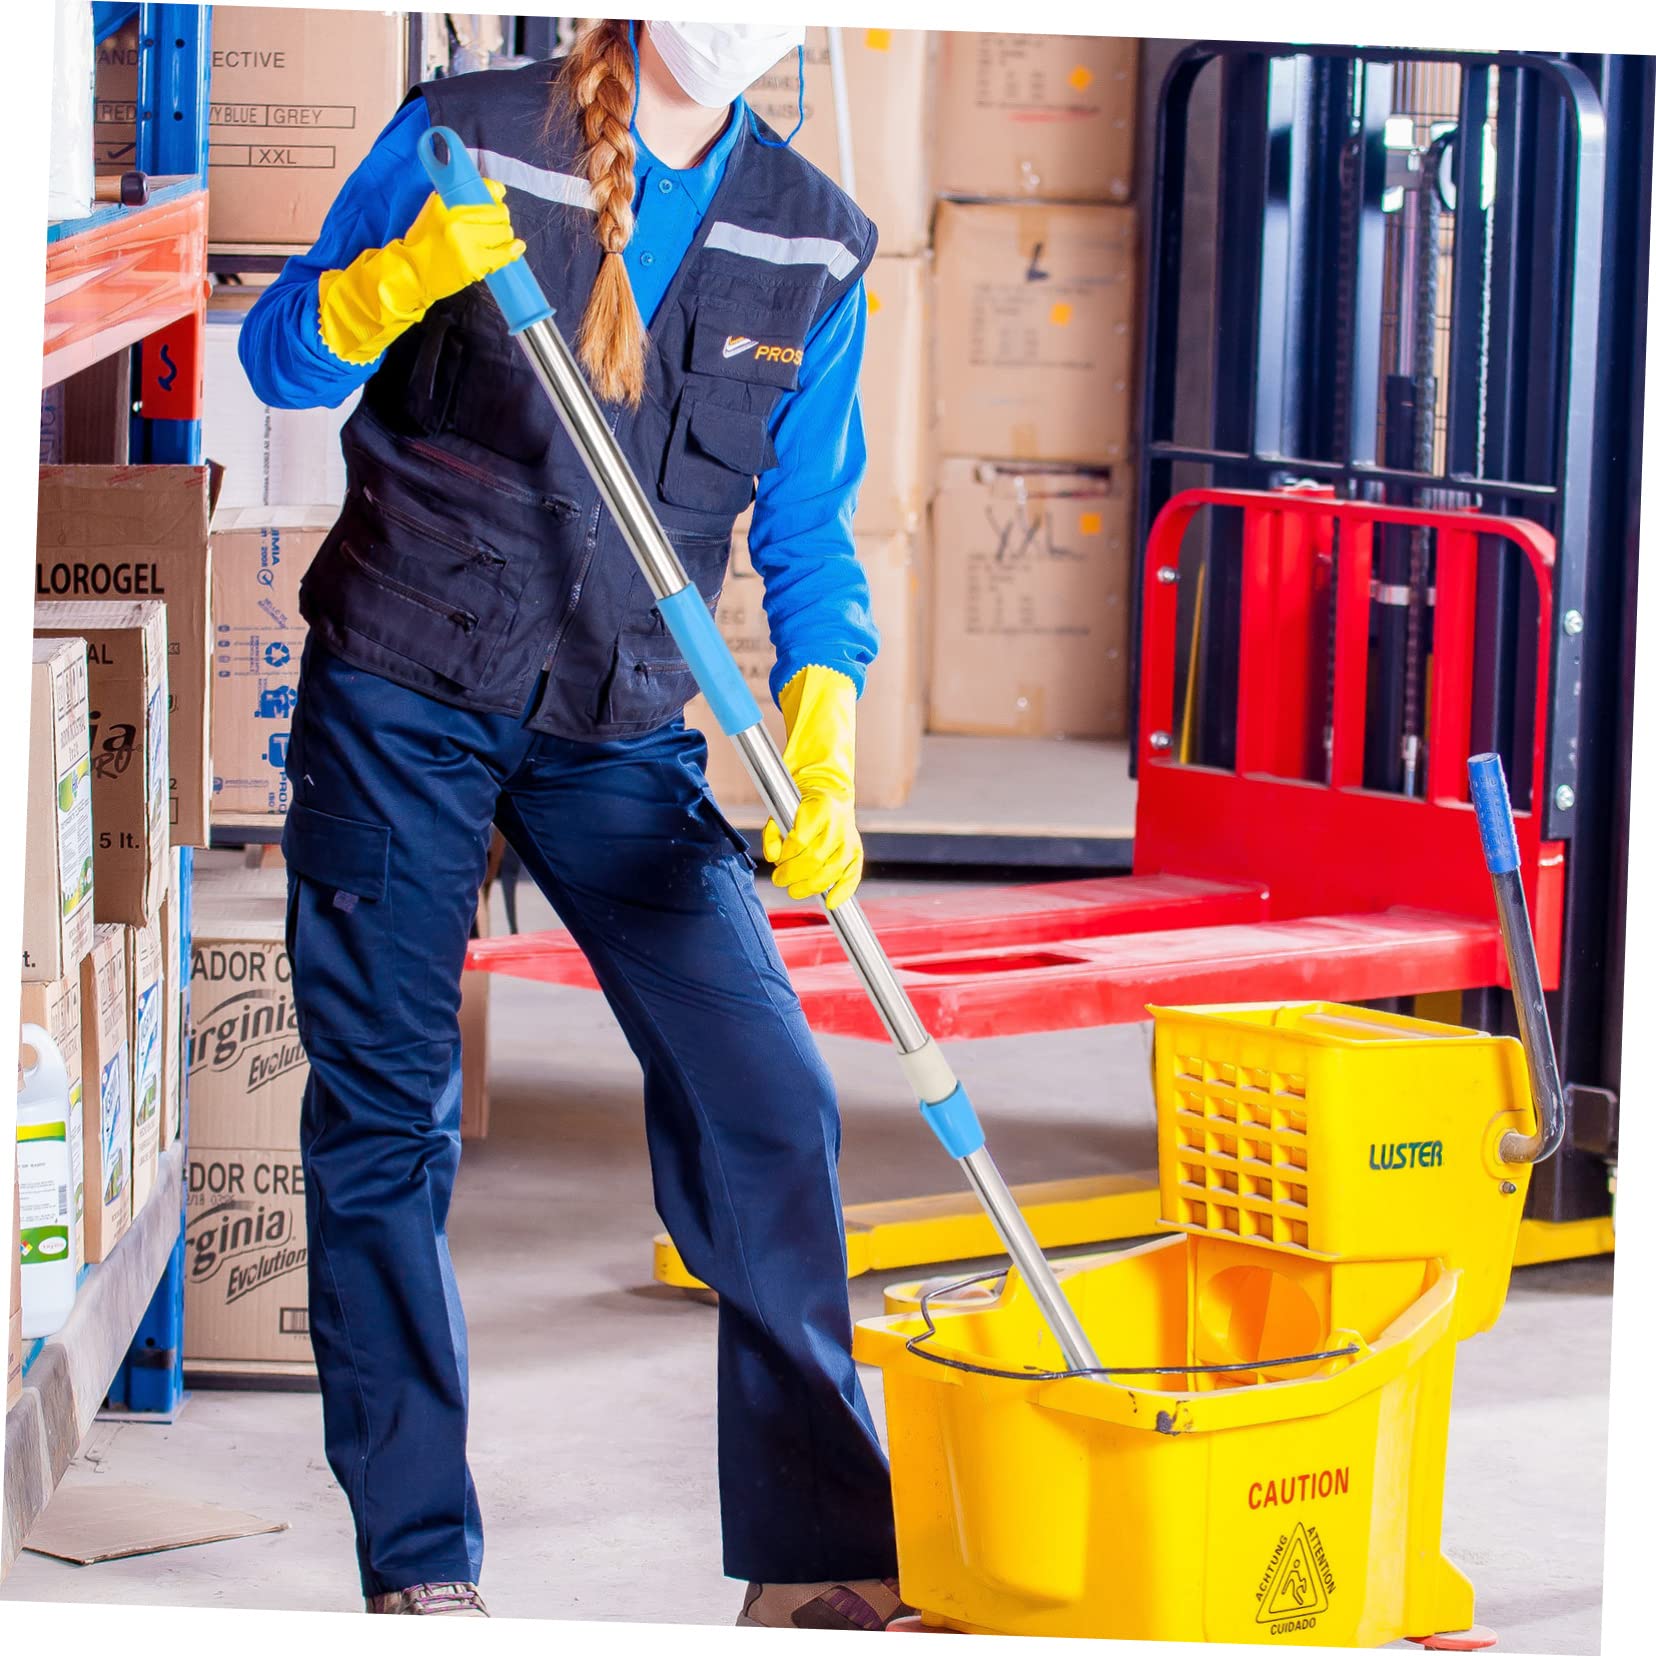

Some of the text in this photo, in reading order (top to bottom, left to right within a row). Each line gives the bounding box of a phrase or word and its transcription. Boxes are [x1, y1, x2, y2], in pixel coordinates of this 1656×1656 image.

[213, 51, 286, 68] ECTIVE
[102, 105, 136, 120] RED
[274, 108, 322, 125] GREY
[258, 149, 296, 164] XXL
[36, 563, 165, 595] LOROGEL
[99, 833, 111, 849] 5
[191, 951, 266, 982] ADOR
[1369, 1140, 1443, 1170] LUSTER
[190, 1162, 305, 1195] DOR CRE
[227, 1247, 307, 1298] Evolution
[1248, 1466, 1349, 1510] CAUTION
[1256, 1535, 1288, 1602] ACHTUNG
[1307, 1526, 1336, 1594] ATTENTION
[1270, 1617, 1316, 1635] CUIDADO
